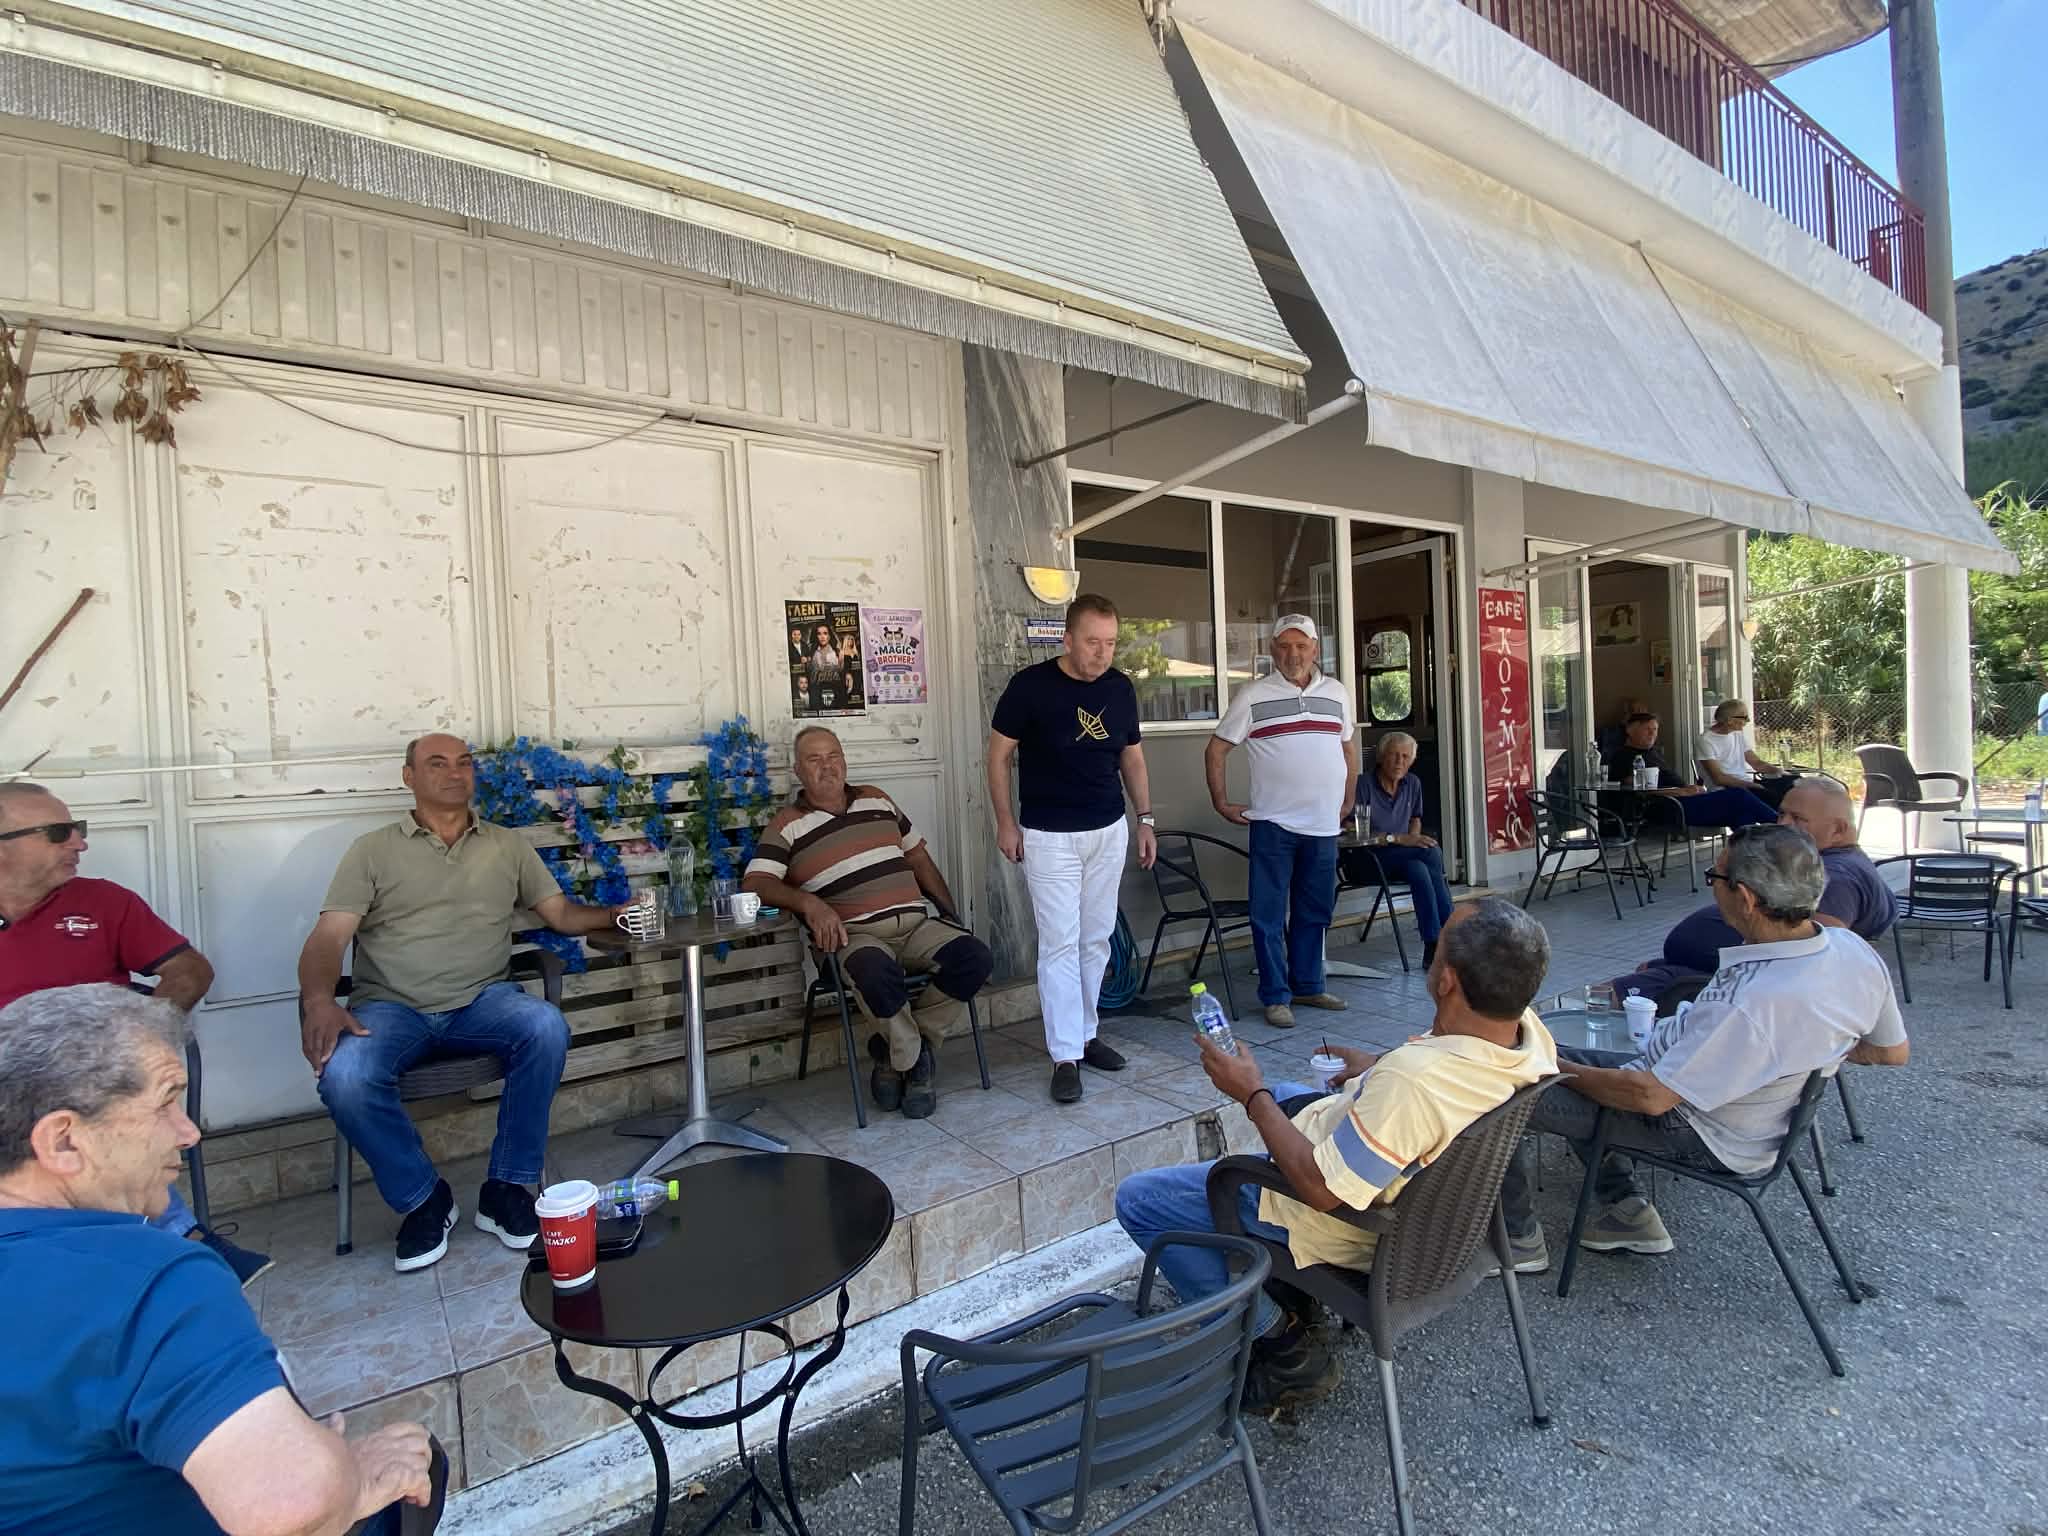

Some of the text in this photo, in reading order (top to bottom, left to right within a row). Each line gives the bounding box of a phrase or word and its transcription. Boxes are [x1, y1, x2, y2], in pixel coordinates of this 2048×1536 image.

[1485, 600, 1523, 622] CAFE
[879, 645, 913, 656] MAGIC
[877, 655, 915, 665] BROTHERS
